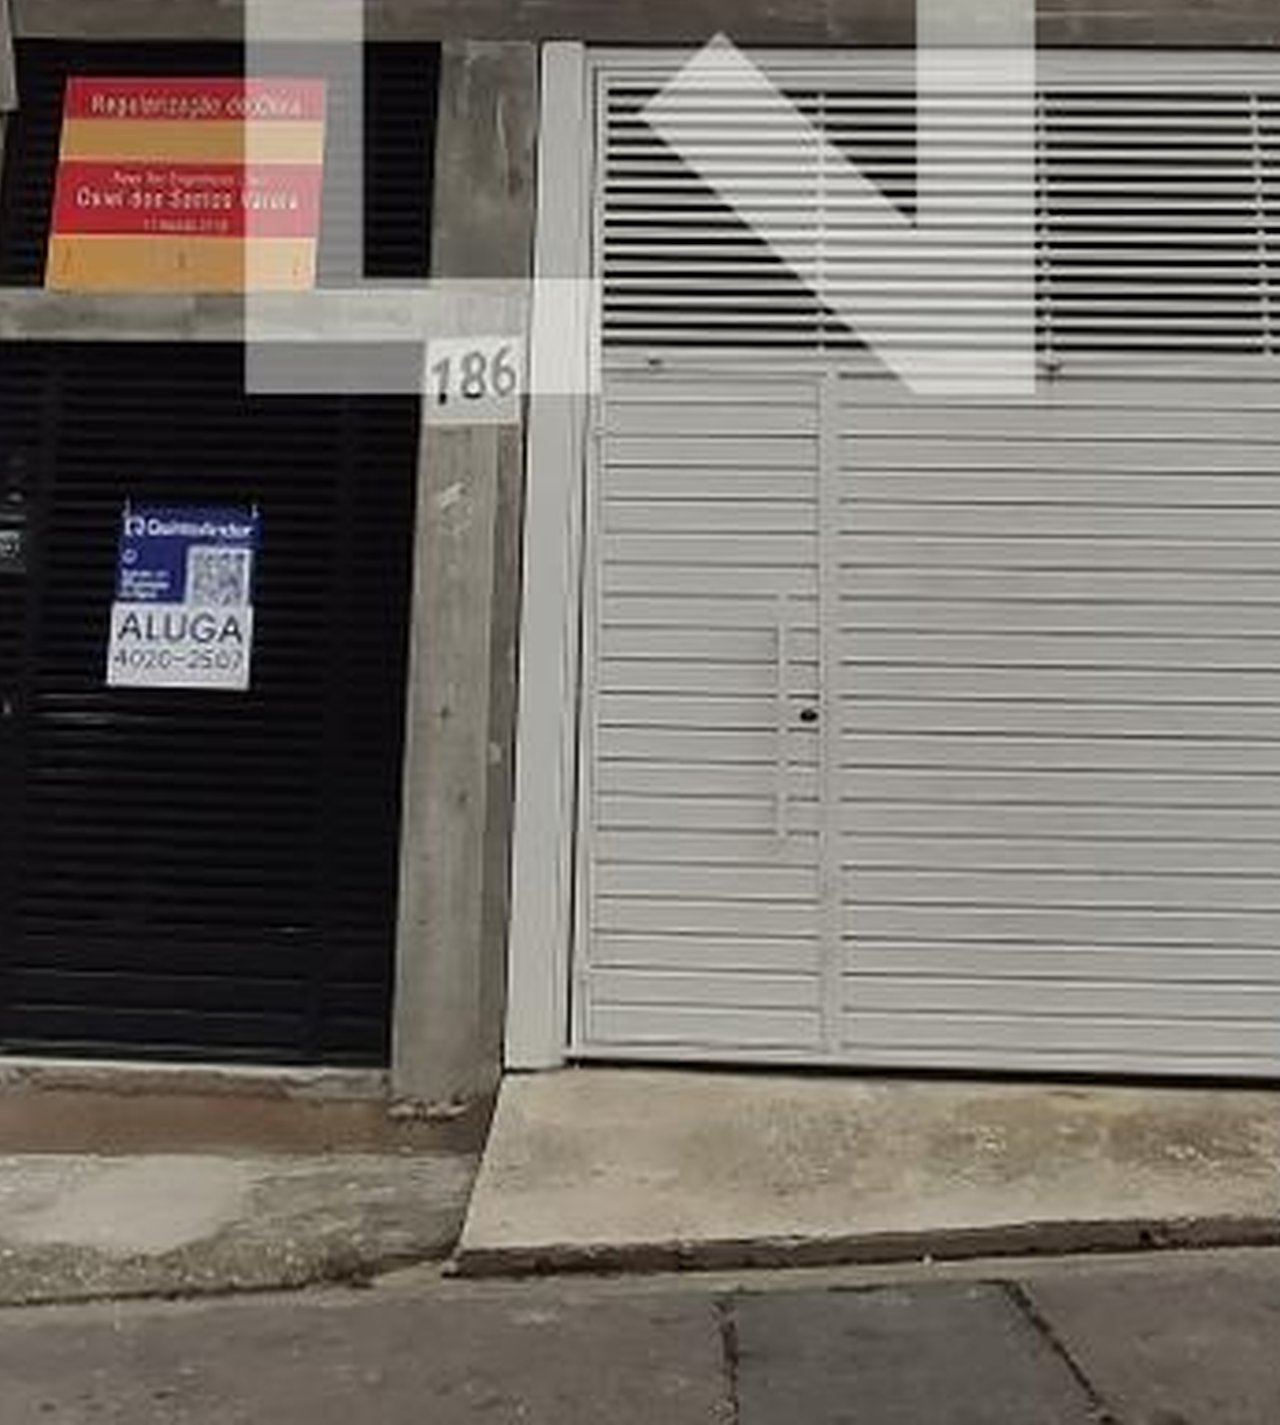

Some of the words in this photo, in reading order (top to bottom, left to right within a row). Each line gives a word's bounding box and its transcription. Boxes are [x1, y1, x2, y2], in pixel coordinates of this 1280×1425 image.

[431, 345, 517, 405] 186
[118, 611, 242, 643] ALUGA
[114, 649, 243, 670] 4020-2507
